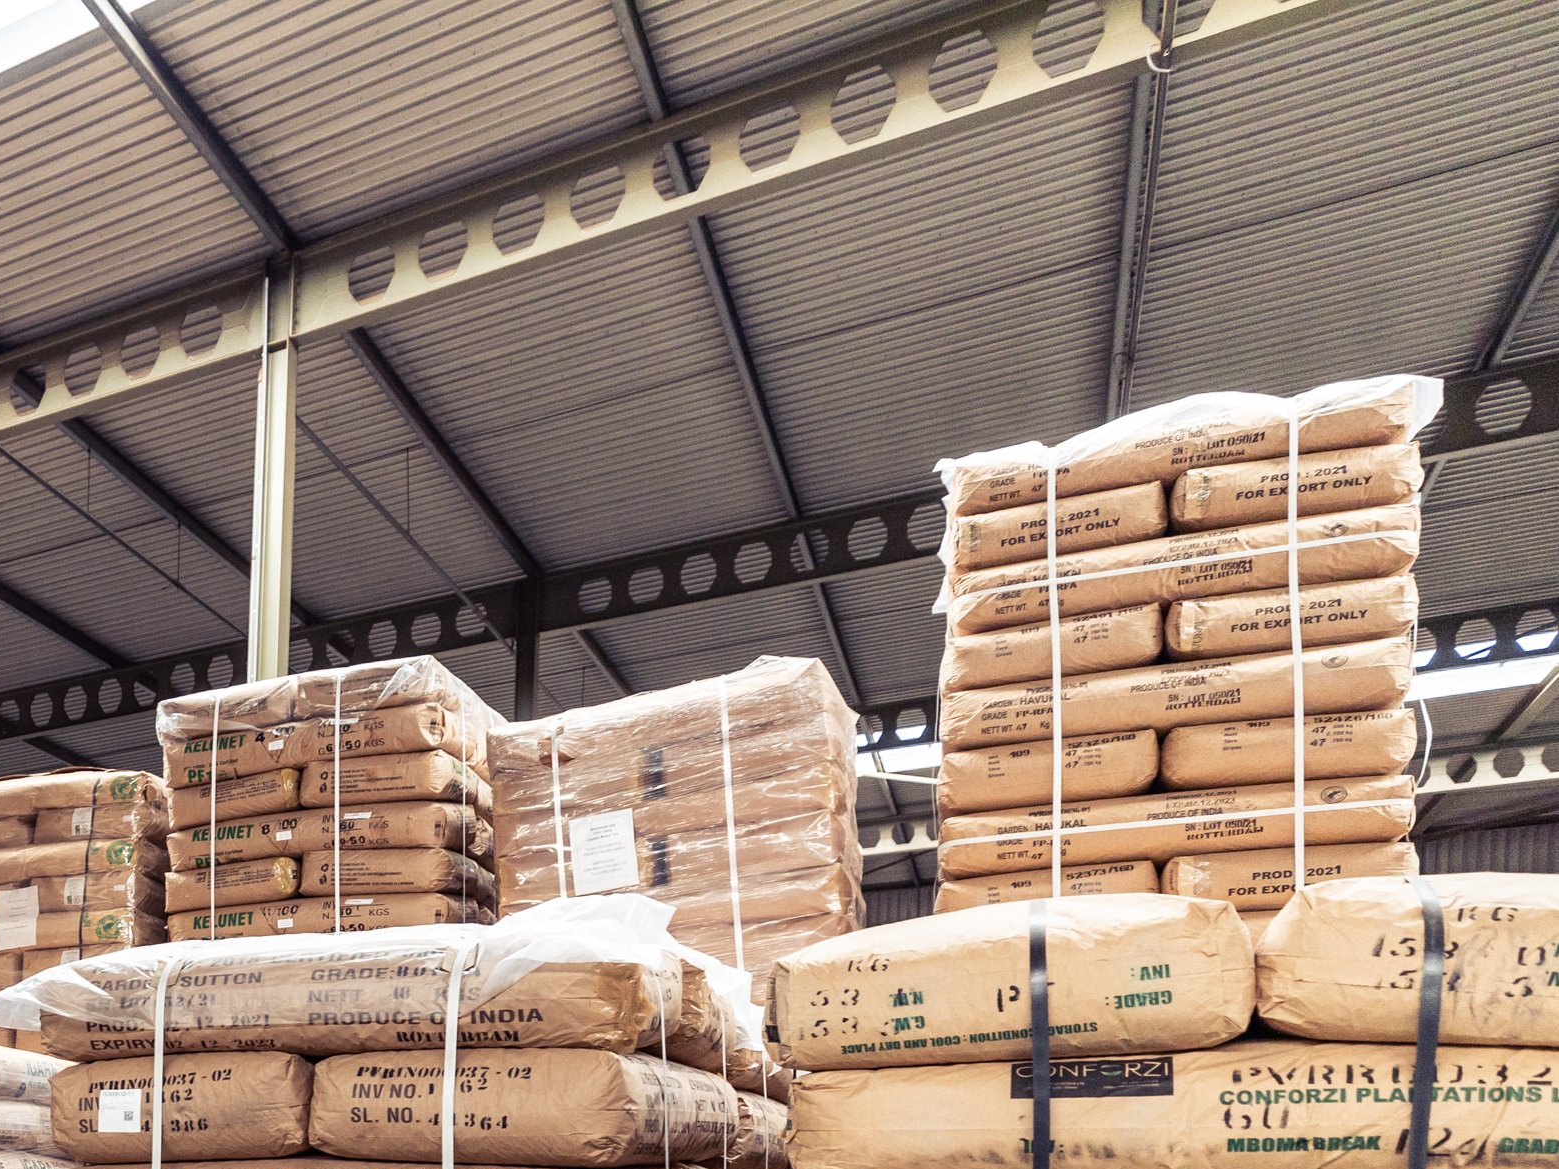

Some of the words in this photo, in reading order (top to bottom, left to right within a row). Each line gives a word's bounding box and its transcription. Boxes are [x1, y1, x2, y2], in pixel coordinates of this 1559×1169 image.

[1314, 465, 1347, 478] 2021
[1236, 488, 1262, 501] FOR
[1267, 480, 1328, 498] EXORT
[1333, 475, 1372, 491] ONLY
[1067, 508, 1100, 521] 2021
[1001, 535, 1026, 548] FOR
[1030, 523, 1080, 544] EXORT
[1086, 517, 1120, 533] ONLY
[1309, 598, 1342, 608] 2021
[1231, 622, 1258, 633] FOR
[1328, 609, 1367, 623] ONLY
[1131, 682, 1168, 692] PRODUCE
[1185, 677, 1206, 687] INDIA
[364, 721, 384, 731] KGS
[364, 739, 385, 748] KGS
[1147, 811, 1184, 821] PRODUCE
[1201, 807, 1223, 816] INDIA
[192, 825, 254, 842] KEUNET
[1308, 865, 1342, 877] 2021
[1228, 886, 1255, 896] FOR
[180, 972, 262, 986] SUTTON
[309, 1011, 420, 1025] PRODUCE
[471, 1008, 543, 1024] INDIA
[840, 1044, 874, 1055] PLACE
[352, 1084, 384, 1098] INV
[1220, 1089, 1347, 1105] CONFORZI
[1357, 1087, 1542, 1103] PLATATIONS
[1227, 1137, 1310, 1152] MBOMA
[1313, 1136, 1381, 1151] BREAK
